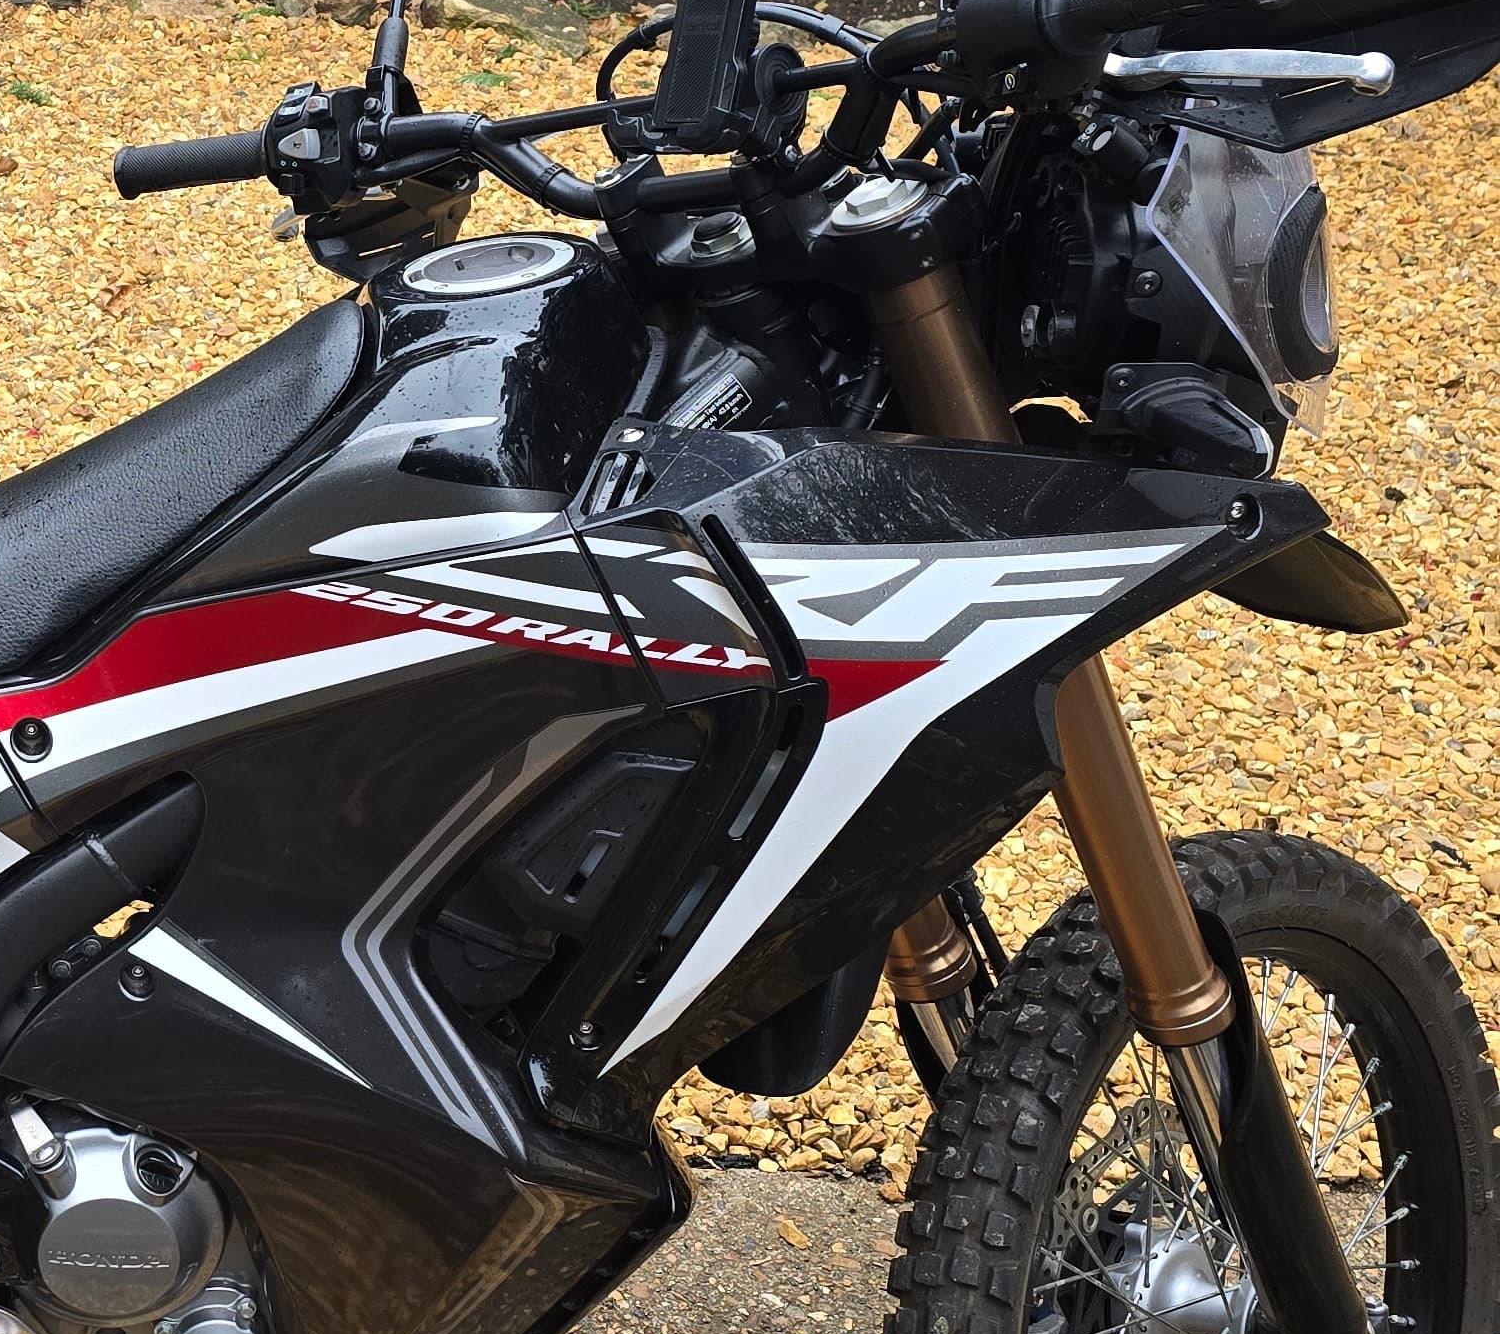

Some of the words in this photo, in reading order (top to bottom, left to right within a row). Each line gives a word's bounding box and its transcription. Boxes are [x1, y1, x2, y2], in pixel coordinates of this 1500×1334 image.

[289, 581, 501, 628] 250
[488, 616, 772, 670] RALLY
[48, 1250, 171, 1269] HONDA
